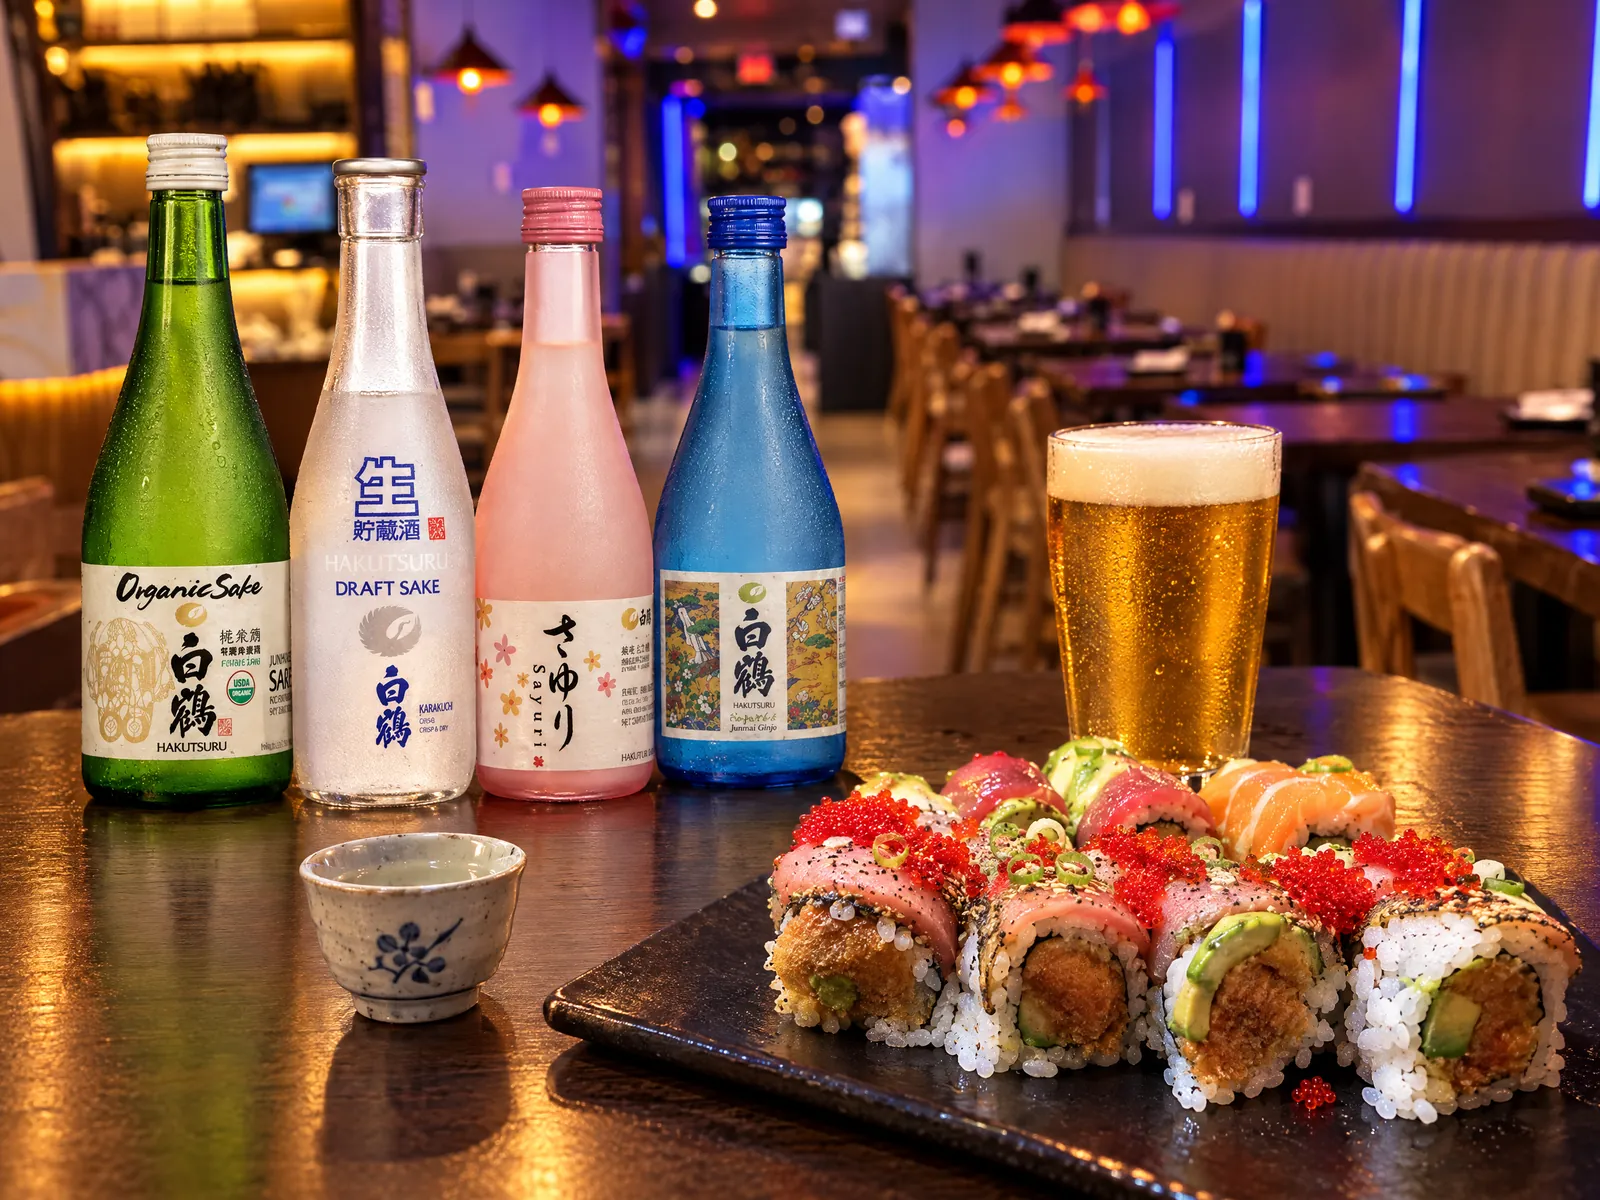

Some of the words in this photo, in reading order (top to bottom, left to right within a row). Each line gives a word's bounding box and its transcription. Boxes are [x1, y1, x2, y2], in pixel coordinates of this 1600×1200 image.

[354, 456, 419, 517] 生
[353, 519, 420, 541] 貯蔵酒
[325, 552, 449, 572] HAKUTSURU
[116, 572, 212, 610] Organic
[210, 573, 263, 600] Sake
[335, 581, 395, 596] DRAFT
[399, 579, 440, 595] SAKE
[733, 608, 775, 698] 白鶴
[170, 632, 217, 738] 白鶴
[233, 678, 250, 687] USDA
[543, 614, 579, 752] さゆり
[376, 664, 412, 749] 白鶴
[529, 664, 546, 747] Sayuri
[157, 741, 227, 752] HAKUTSURU
[729, 724, 756, 732] Junmai
[758, 724, 777, 732] Ginjo
